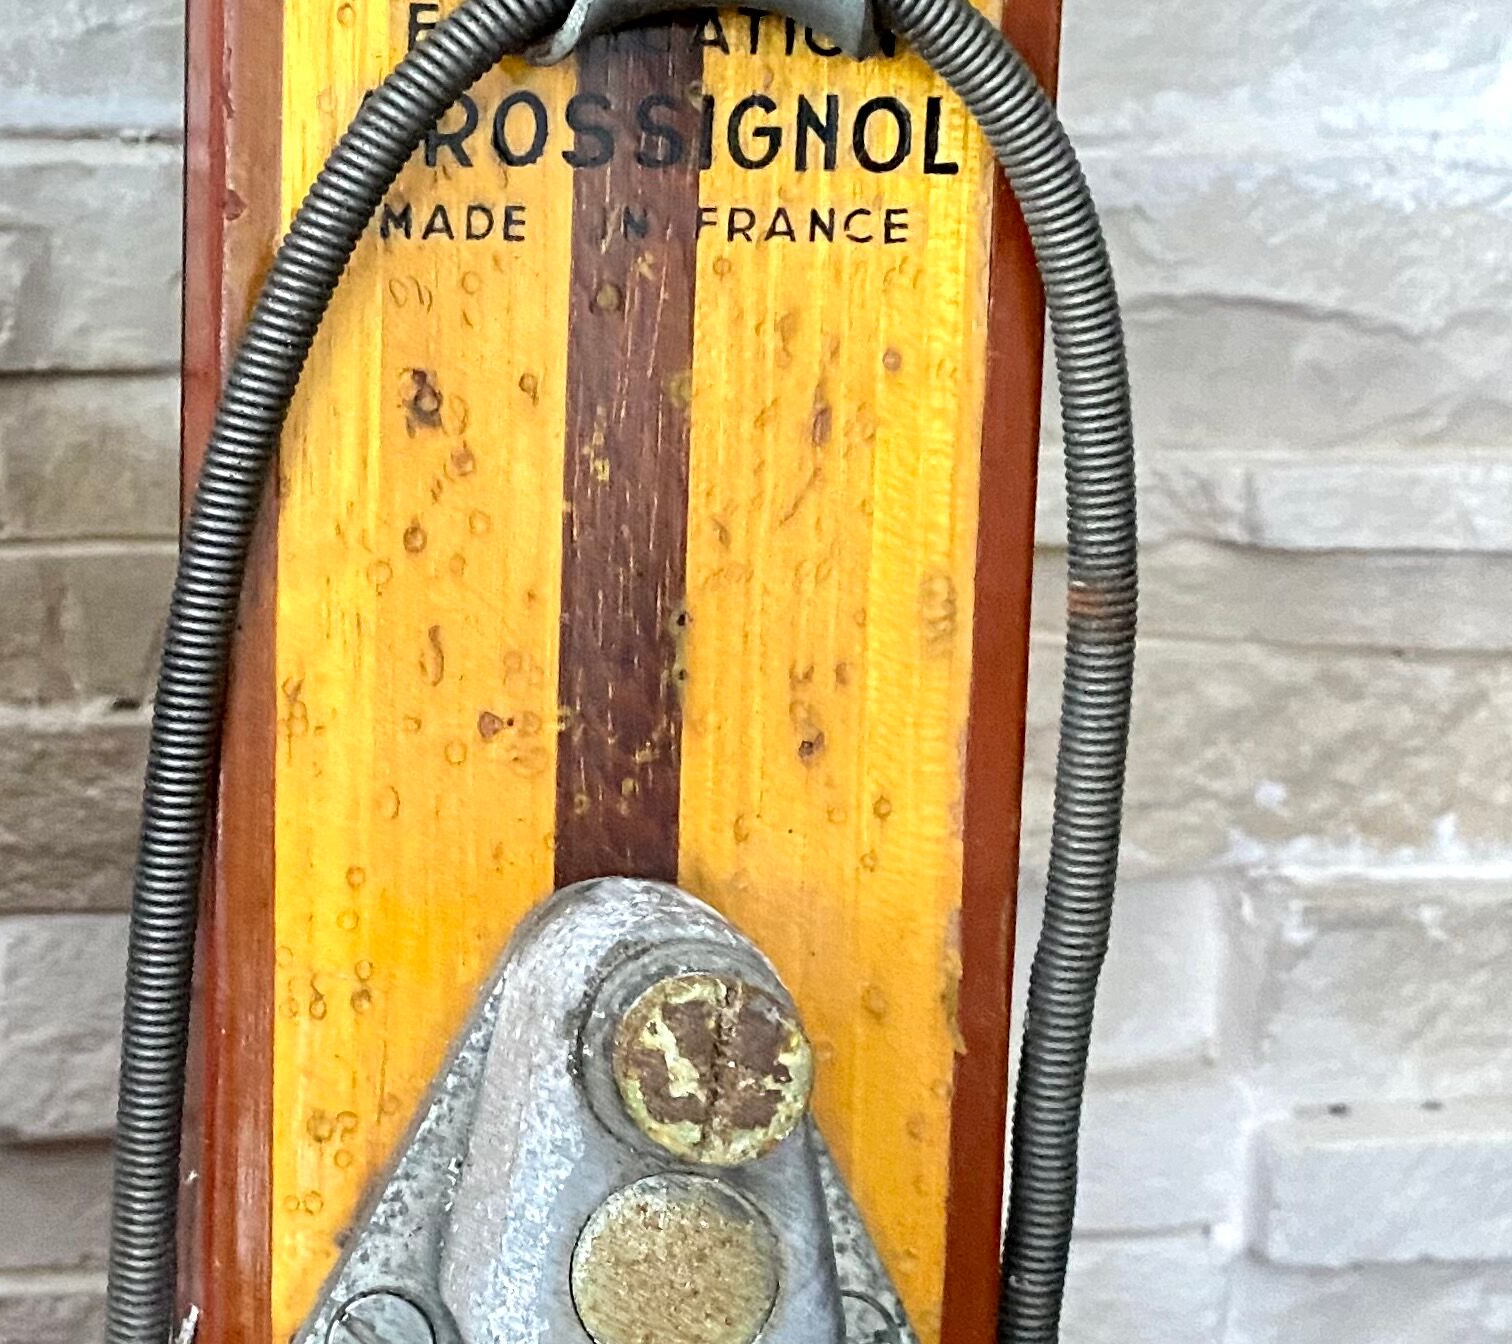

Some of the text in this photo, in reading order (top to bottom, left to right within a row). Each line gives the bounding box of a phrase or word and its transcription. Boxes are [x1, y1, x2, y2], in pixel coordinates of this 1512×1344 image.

[425, 89, 960, 176] ROSSIGNOL
[378, 202, 527, 244] MADE
[694, 205, 911, 245] FRANCE
